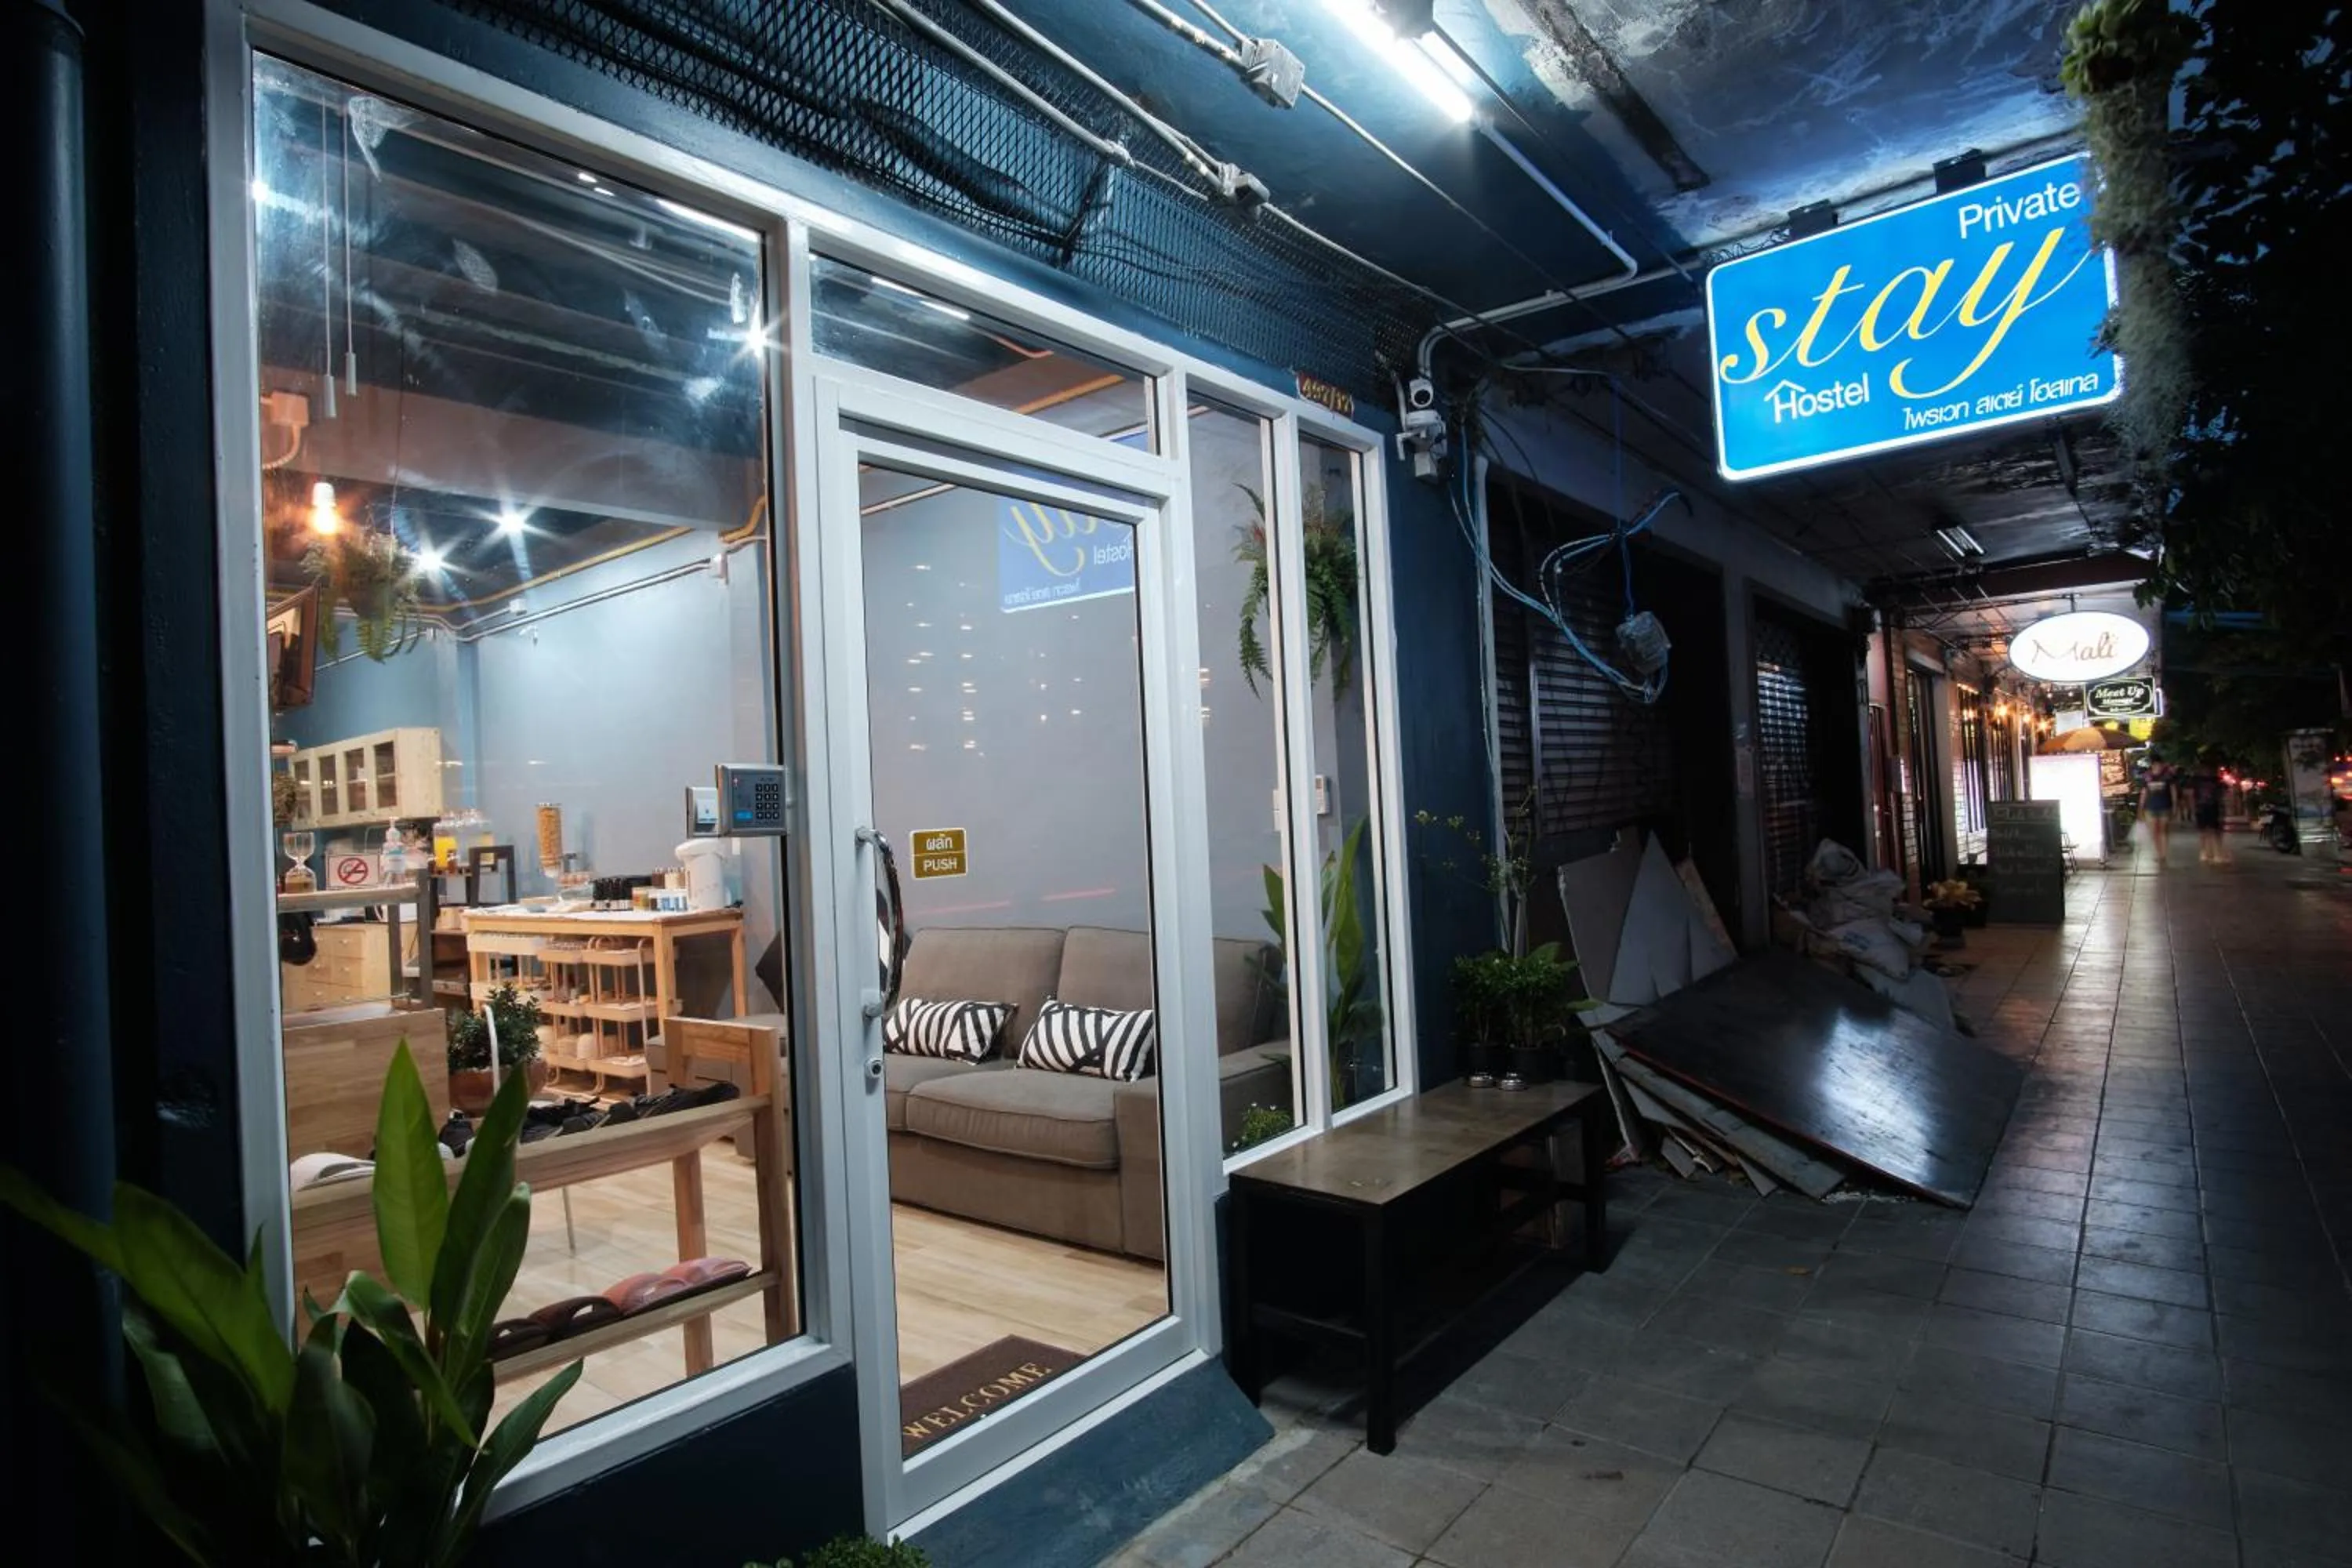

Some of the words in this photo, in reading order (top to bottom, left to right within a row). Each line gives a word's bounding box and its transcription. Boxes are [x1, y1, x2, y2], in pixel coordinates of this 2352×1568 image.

[1958, 181, 2080, 238] Private
[1719, 227, 2092, 400] stay
[1772, 374, 1869, 423] Hostel
[1903, 401, 1969, 430] ไพรเวท
[2032, 631, 2120, 665] Mali
[2127, 685, 2145, 699] Up
[923, 857, 958, 872] PUSH
